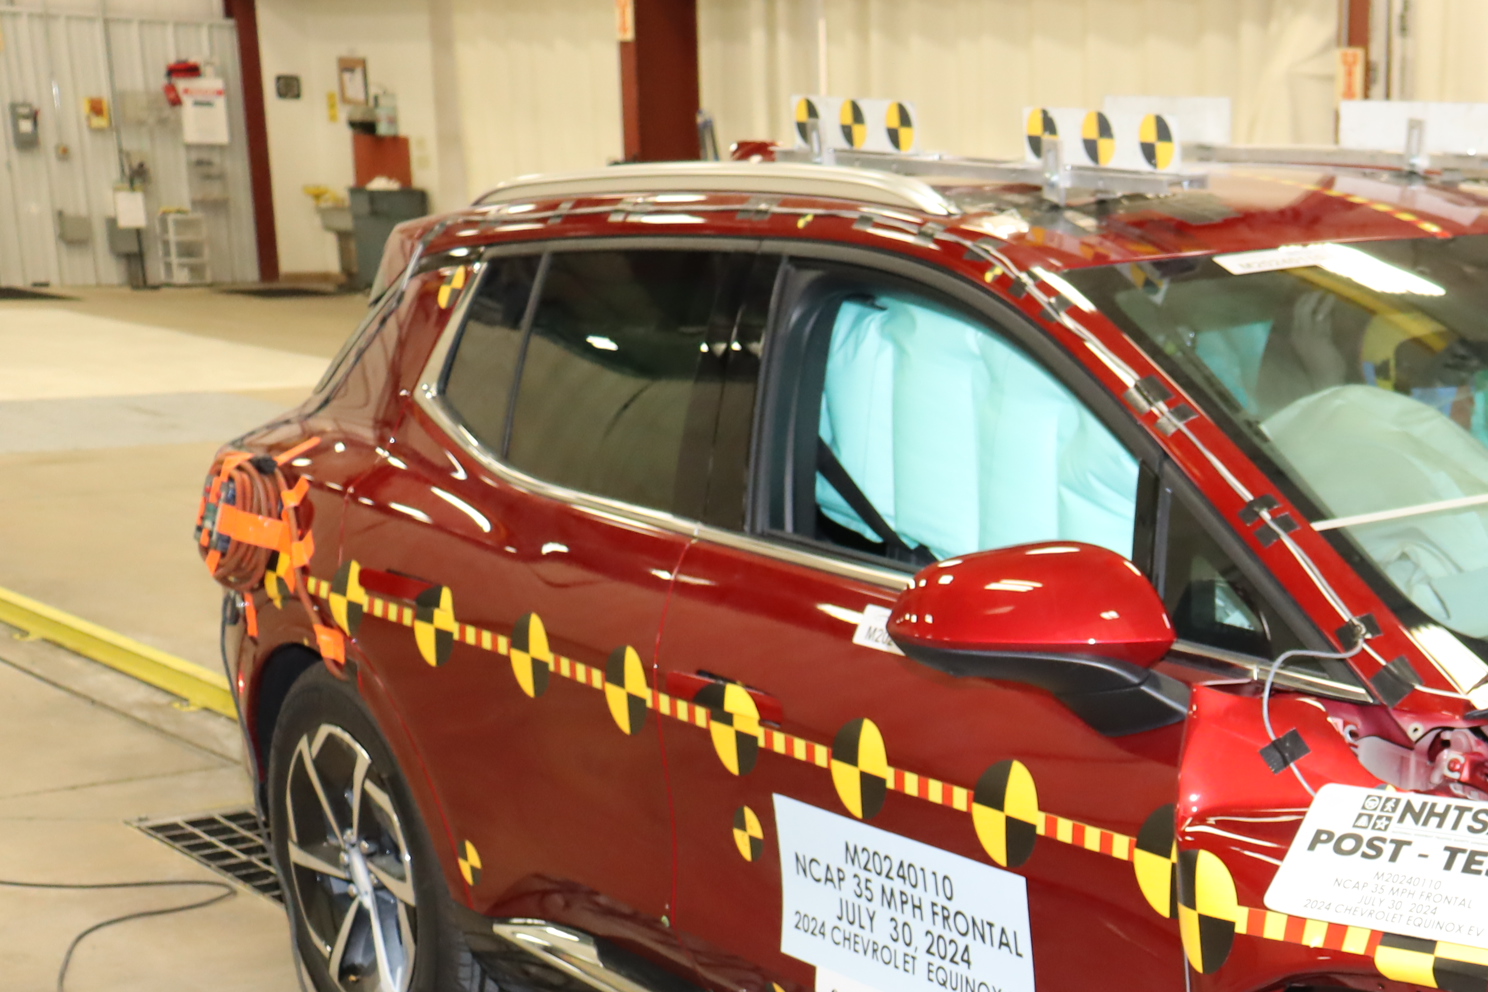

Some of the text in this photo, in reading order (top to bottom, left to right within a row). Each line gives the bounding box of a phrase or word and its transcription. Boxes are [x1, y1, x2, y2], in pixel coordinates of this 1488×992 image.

[1307, 829, 1412, 863] POST
[845, 841, 953, 902] M20240110
[1373, 871, 1442, 890] M20240110
[795, 851, 1023, 958] NCAP 35 MPH FRONTAL
[1333, 877, 1473, 909] NCAP 35 MPH FRONTAL
[1357, 894, 1385, 907] JULY
[1405, 902, 1438, 916] 2024
[836, 897, 971, 970] JULY 30, 2024
[1303, 898, 1485, 938] 2024 CHEVROLET EQUINOX EV
[794, 910, 826, 940] 2024
[831, 925, 917, 975] CHEVROLET
